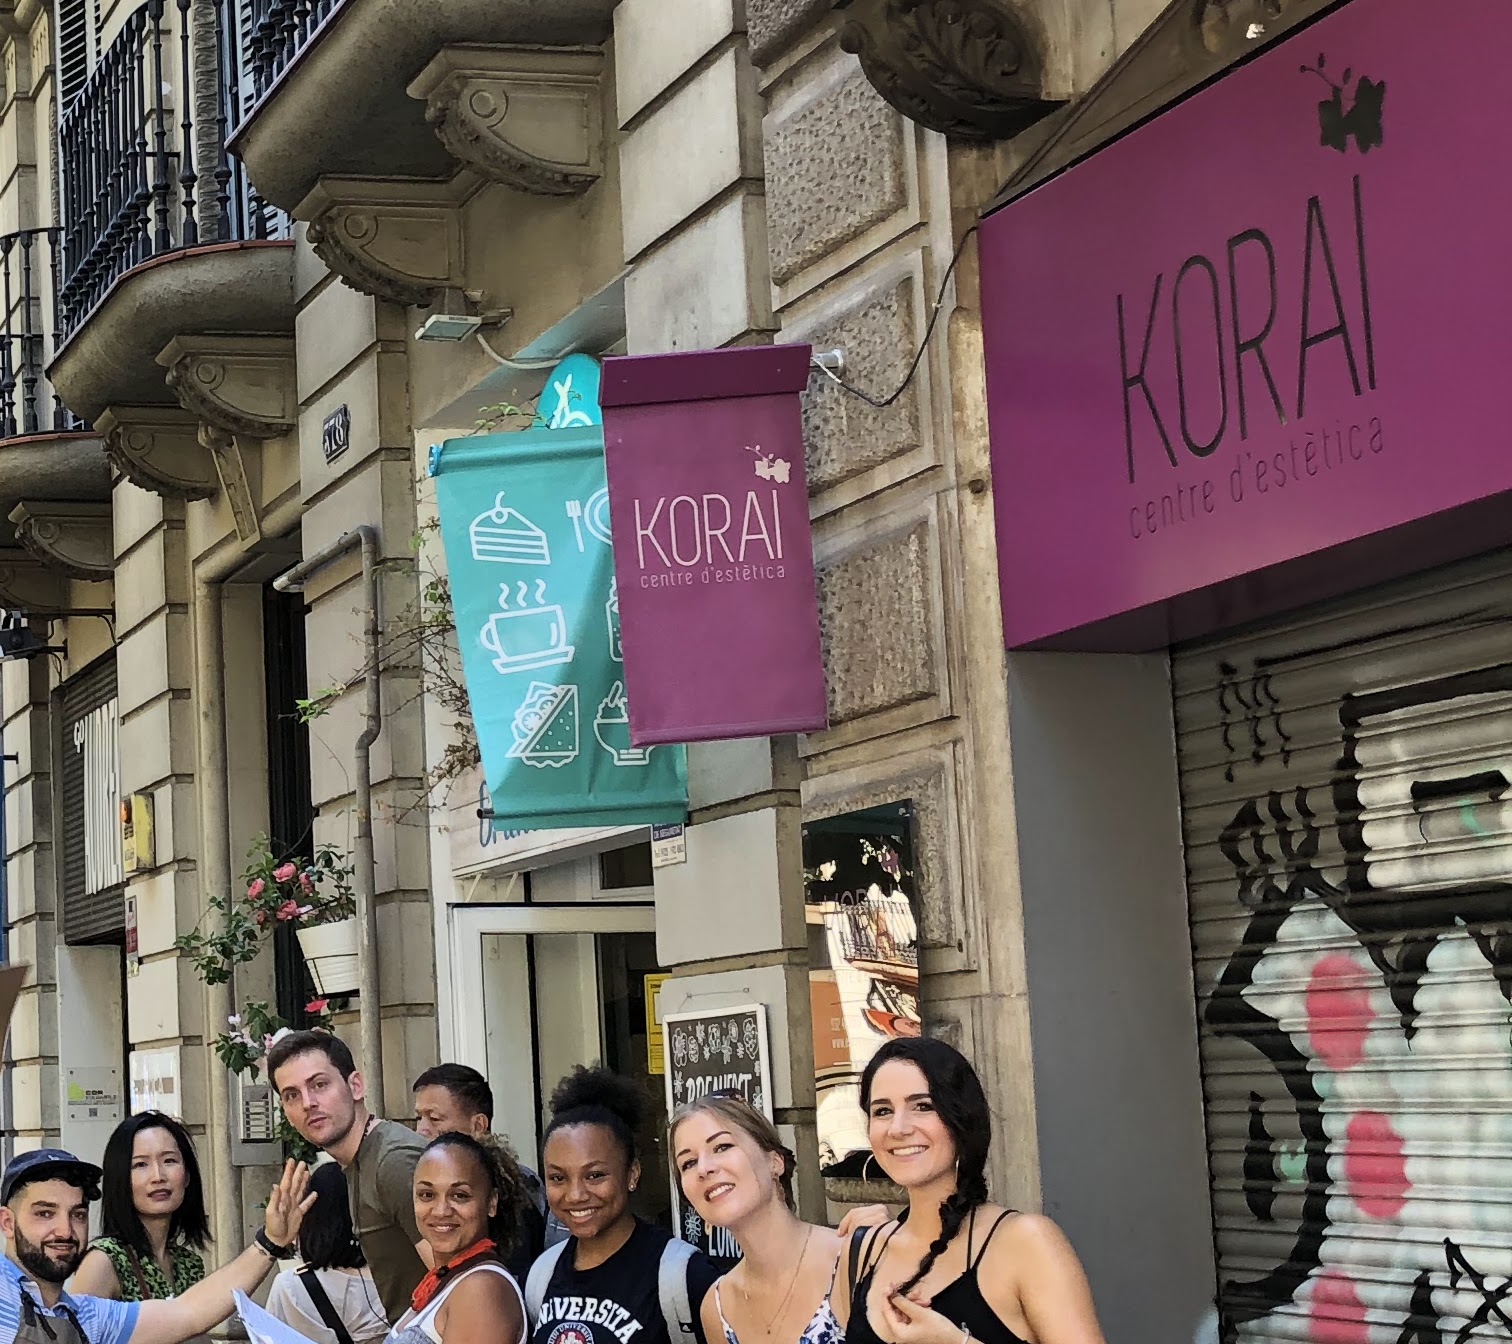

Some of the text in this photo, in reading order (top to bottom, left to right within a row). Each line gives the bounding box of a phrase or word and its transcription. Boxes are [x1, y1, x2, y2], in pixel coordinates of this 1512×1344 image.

[1115, 174, 1376, 485] KORAI
[1129, 416, 1384, 540] centre d'estètica
[634, 489, 783, 570] KORAI
[640, 564, 785, 589] centre d'estètica
